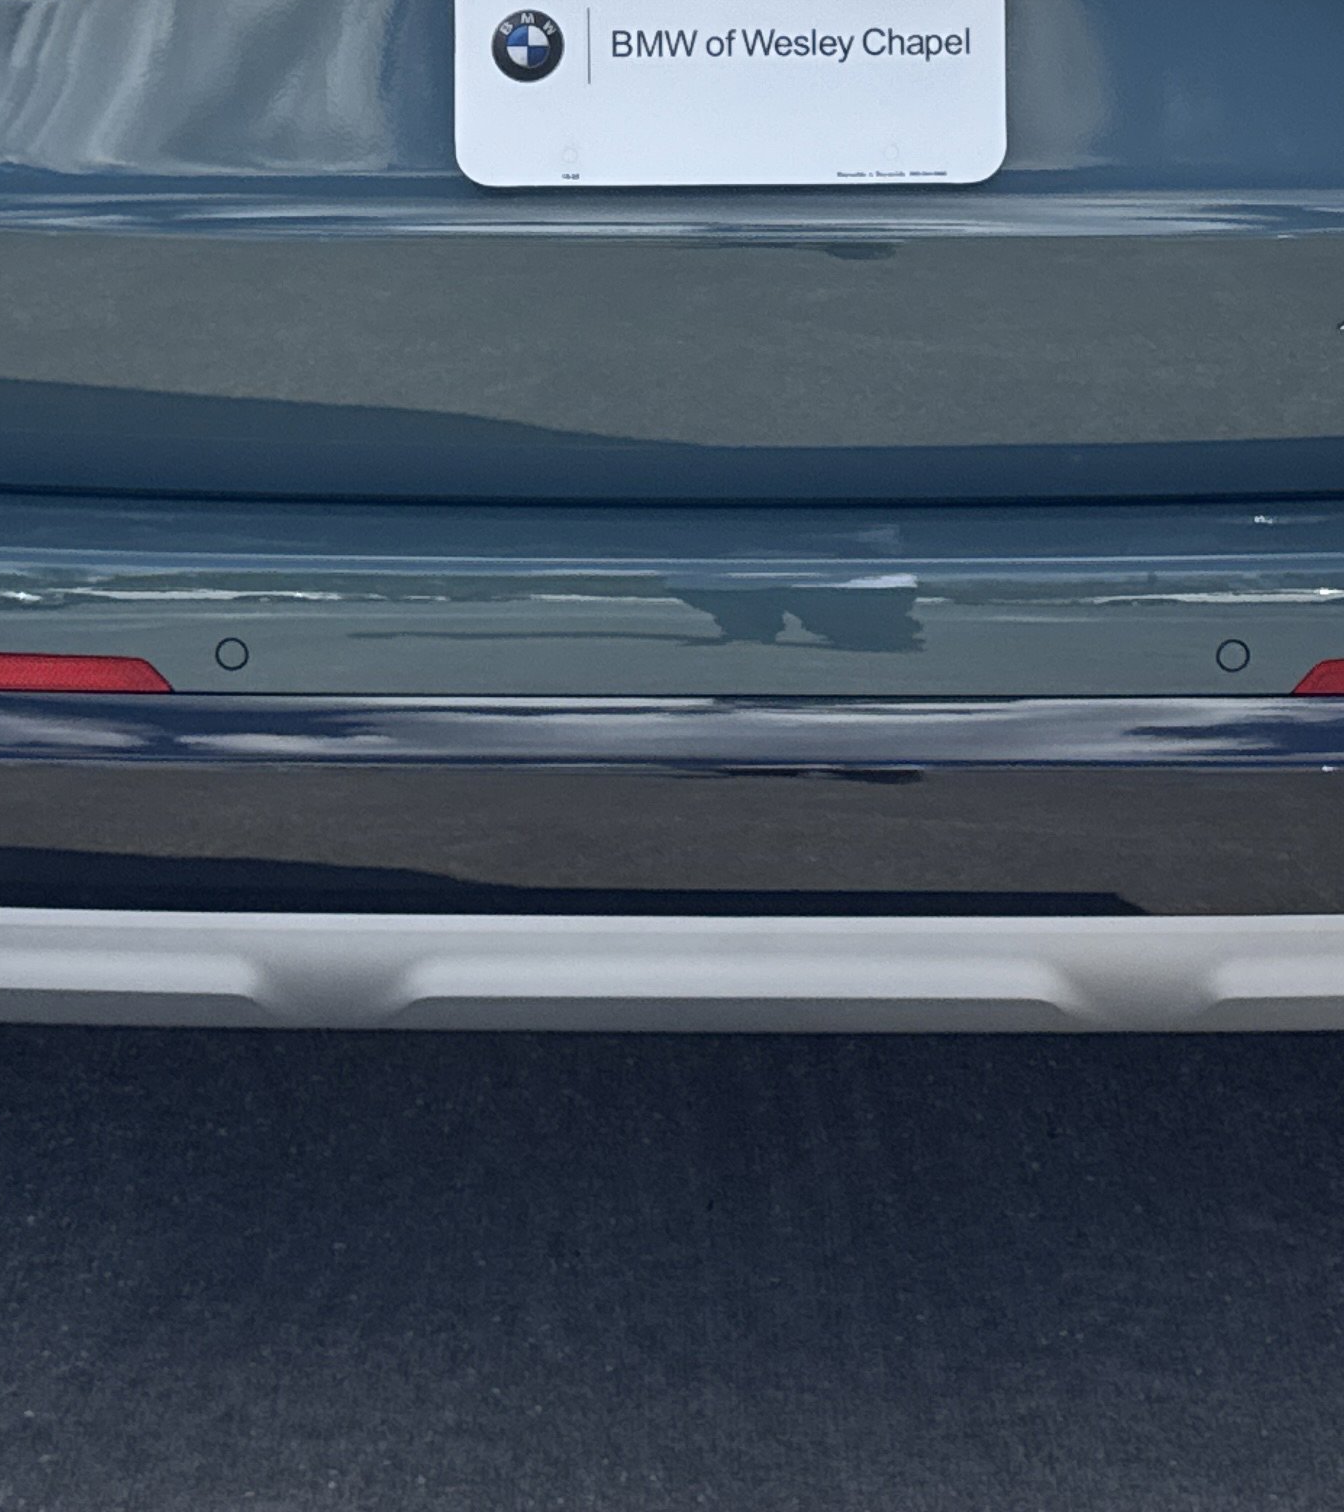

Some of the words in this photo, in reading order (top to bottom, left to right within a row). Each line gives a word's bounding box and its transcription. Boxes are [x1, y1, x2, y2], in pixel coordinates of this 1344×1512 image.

[499, 12, 557, 36] BMW
[612, 29, 698, 57] BMW
[706, 28, 737, 57] of
[741, 27, 855, 63] Wesley
[862, 27, 970, 62] Chapel
